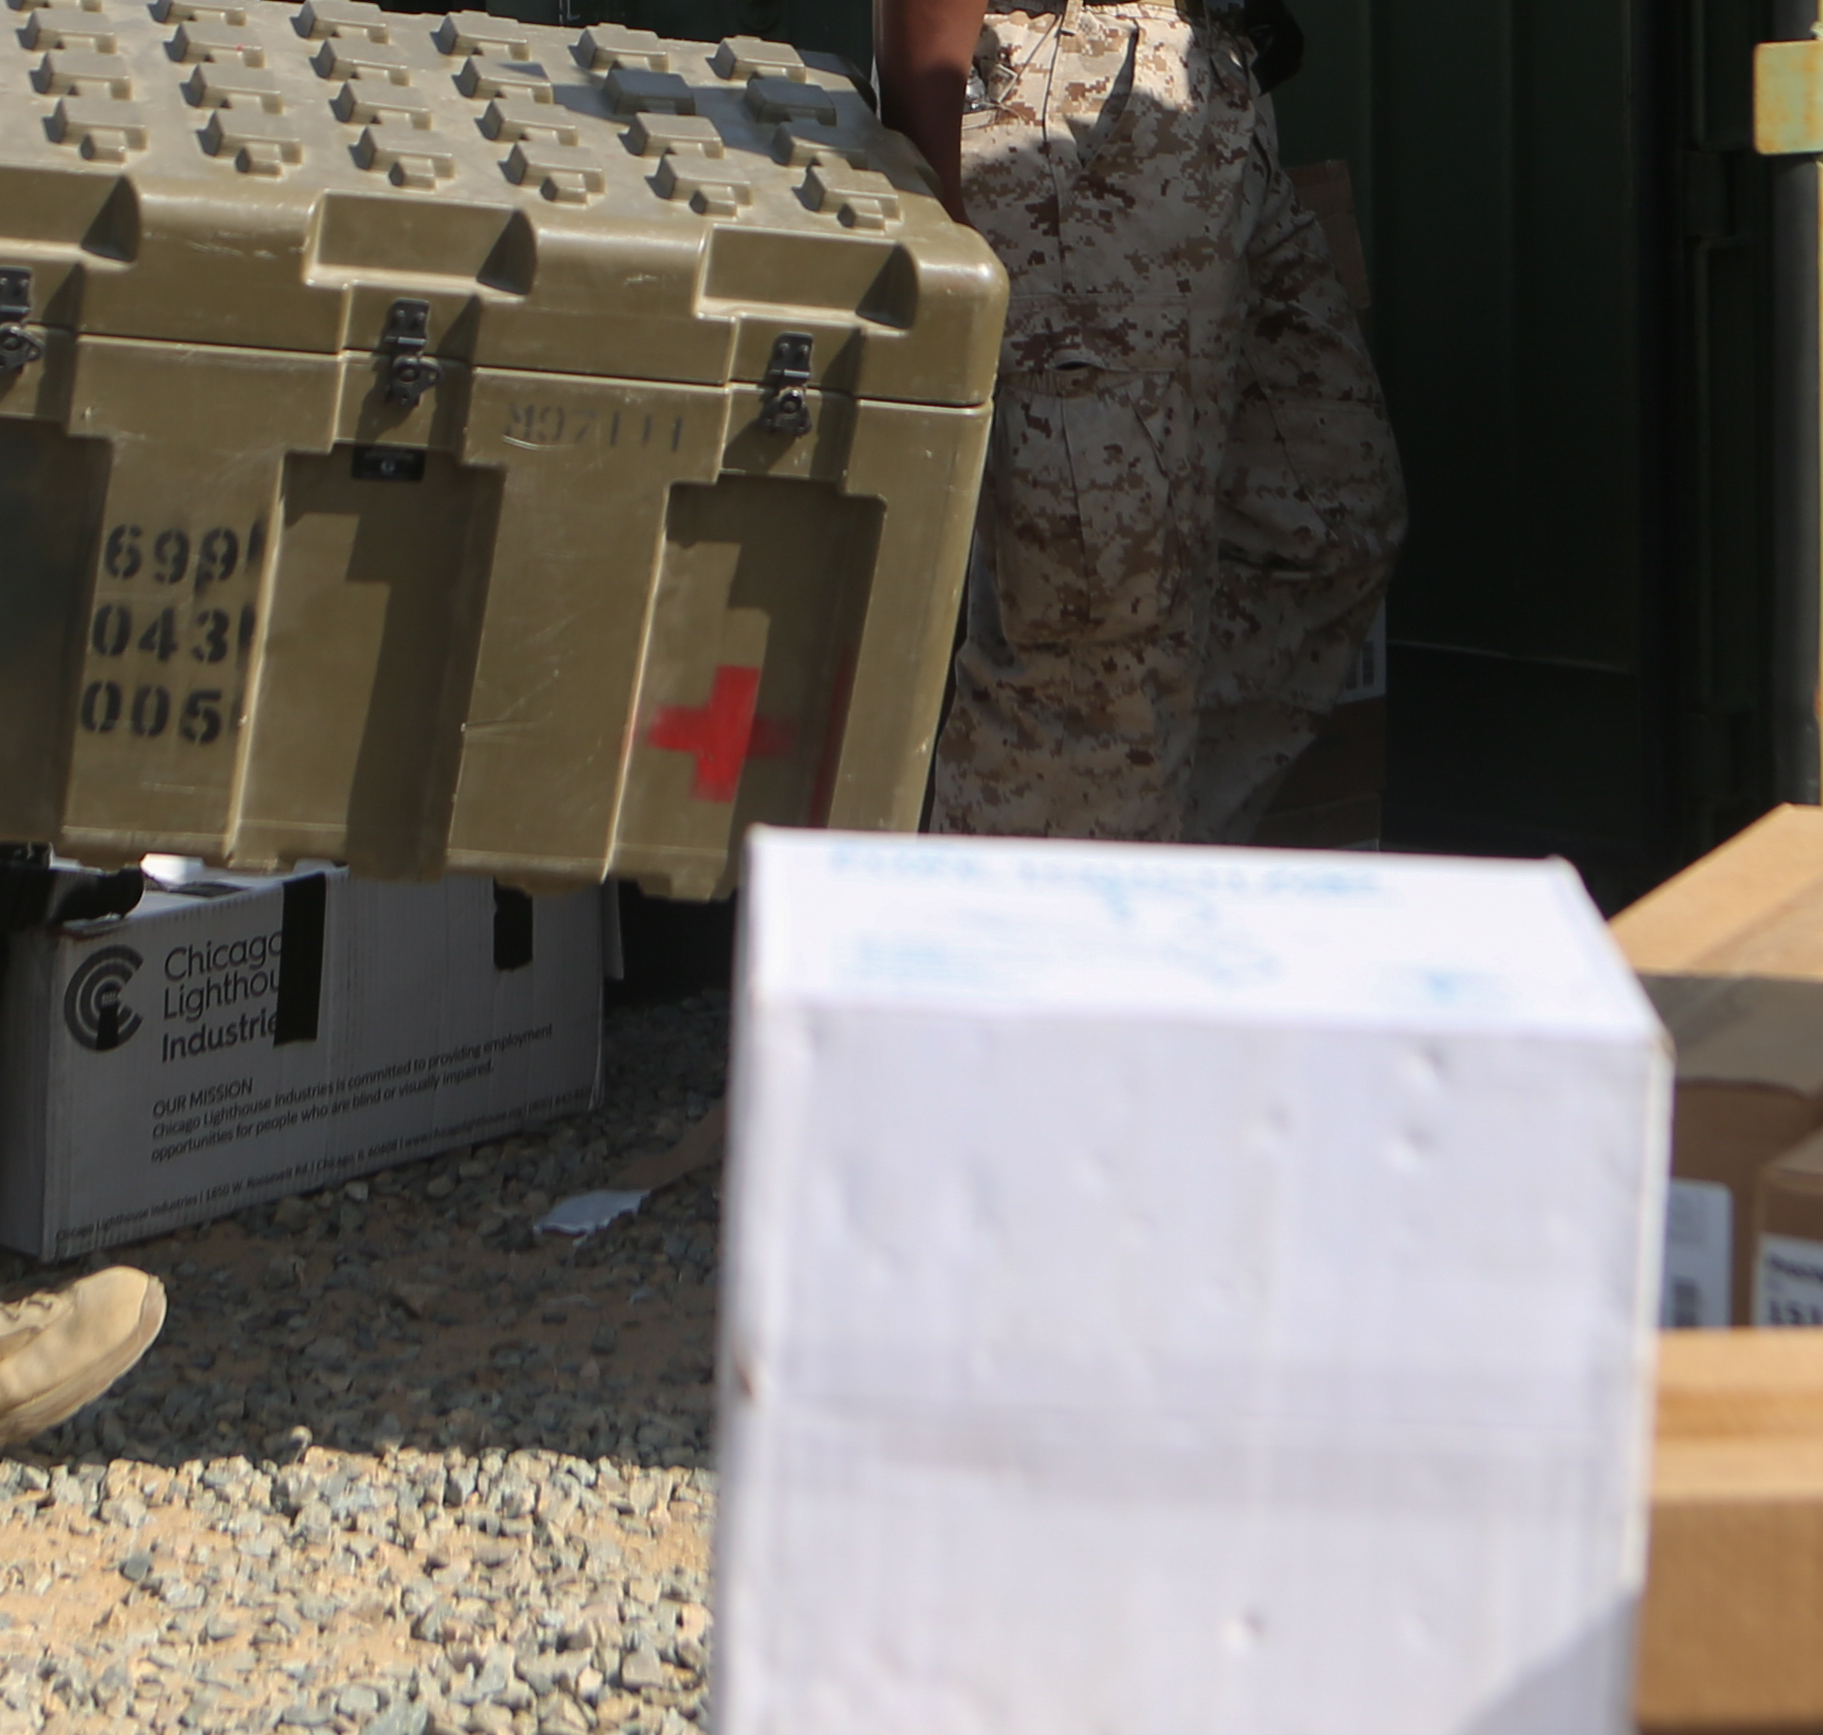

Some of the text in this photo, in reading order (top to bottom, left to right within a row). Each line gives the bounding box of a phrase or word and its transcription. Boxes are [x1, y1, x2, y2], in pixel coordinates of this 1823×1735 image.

[164, 970, 280, 1022] Lighthou
[162, 1007, 279, 1062] Industrie
[153, 1113, 201, 1140] Chicago
[203, 1099, 271, 1127] Lighthouse
[275, 1079, 334, 1106] Industries
[348, 1059, 411, 1089] committed
[414, 1057, 426, 1071] to
[428, 1043, 481, 1071] providing
[484, 1024, 553, 1054] employment
[153, 1077, 253, 1118] OUR MISSION
[151, 1128, 234, 1163] opportunities
[236, 1123, 253, 1140] for
[256, 1110, 298, 1137] people
[301, 1104, 327, 1122] who
[332, 1098, 350, 1114] are
[353, 1089, 381, 1109] blind
[399, 1072, 440, 1096] visually
